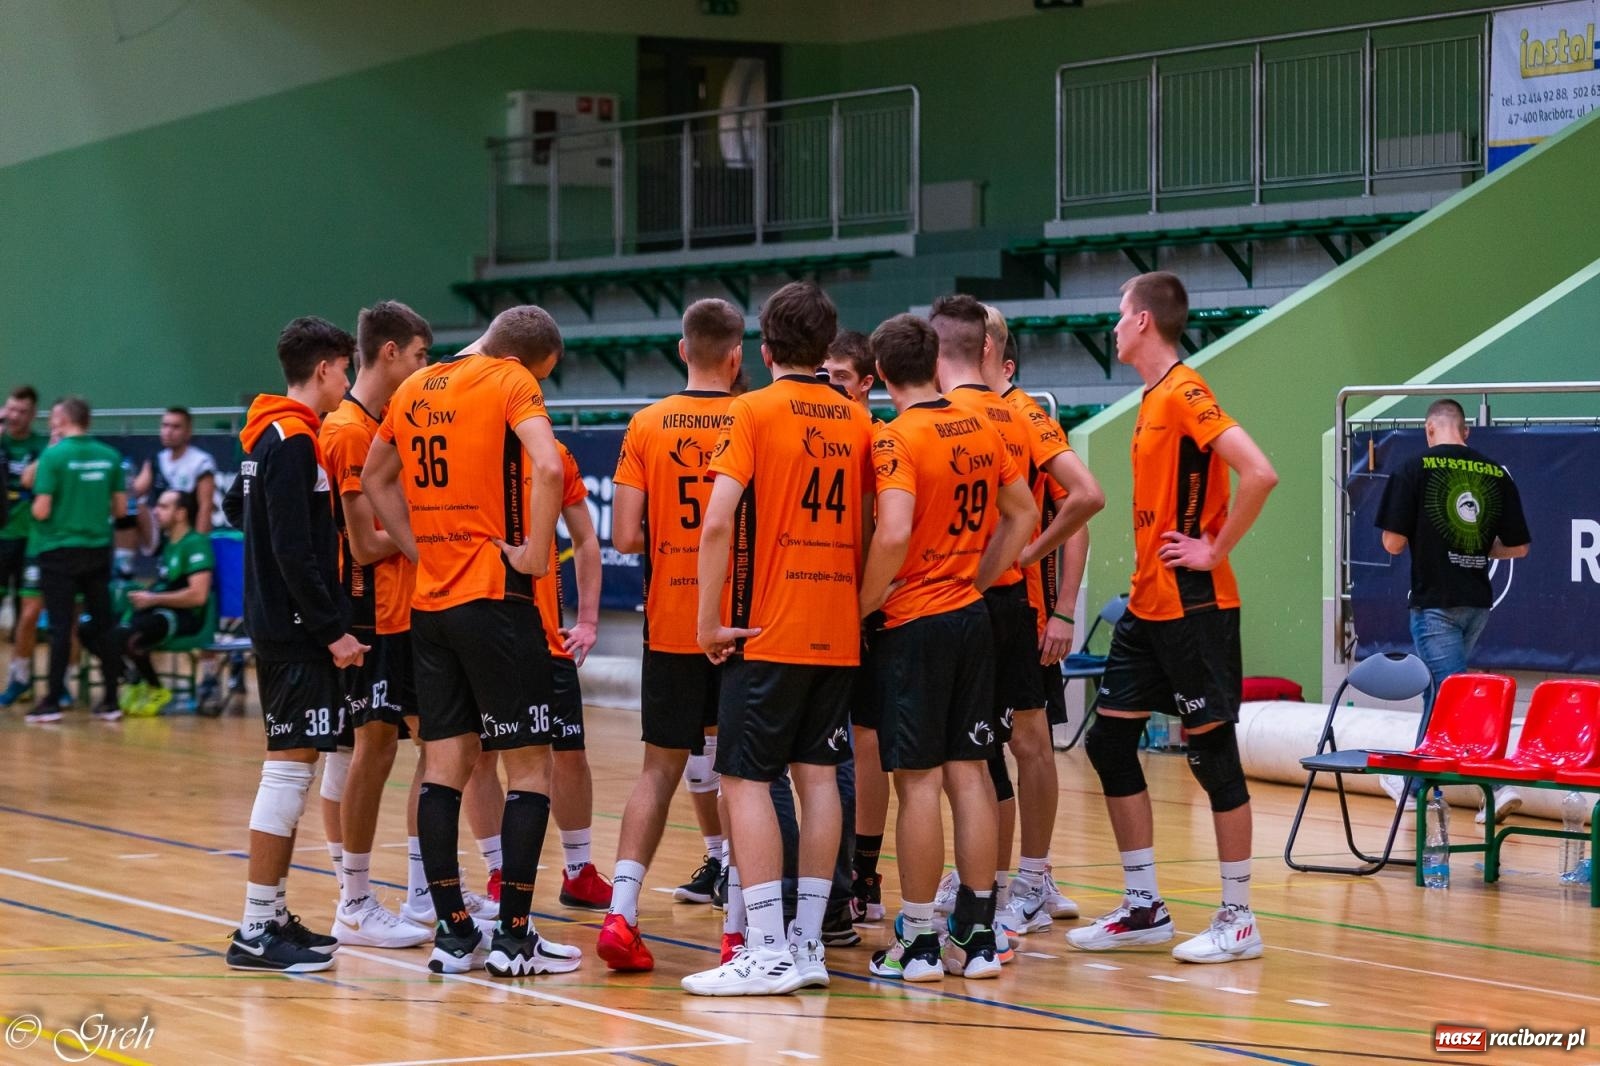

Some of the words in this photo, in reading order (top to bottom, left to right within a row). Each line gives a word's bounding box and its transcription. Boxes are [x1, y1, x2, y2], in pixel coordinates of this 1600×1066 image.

[1520, 23, 1595, 79] instal
[1517, 94, 1528, 106] 32
[1543, 90, 1554, 104] 92
[1573, 86, 1589, 99] 502
[1508, 112, 1537, 126] 47-400
[423, 376, 449, 391] KUTS
[427, 409, 457, 428] JSW
[790, 399, 852, 421] ŁUCZKOWSKI
[822, 441, 853, 459] JSW
[411, 435, 449, 489] 36
[967, 452, 995, 474] JSW
[801, 466, 847, 525] 44
[444, 503, 479, 512] Górnictwo
[948, 479, 989, 536] 39
[1136, 510, 1156, 528] SW
[415, 532, 473, 545] astrzębie-Zdrój
[785, 569, 853, 585] Jastrzębie-Zdrój
[372, 679, 389, 709] 62
[1183, 696, 1207, 714] JSW
[305, 707, 331, 737] 38
[528, 704, 550, 734] 36
[269, 722, 294, 737] JSW
[493, 721, 519, 737] JSW
